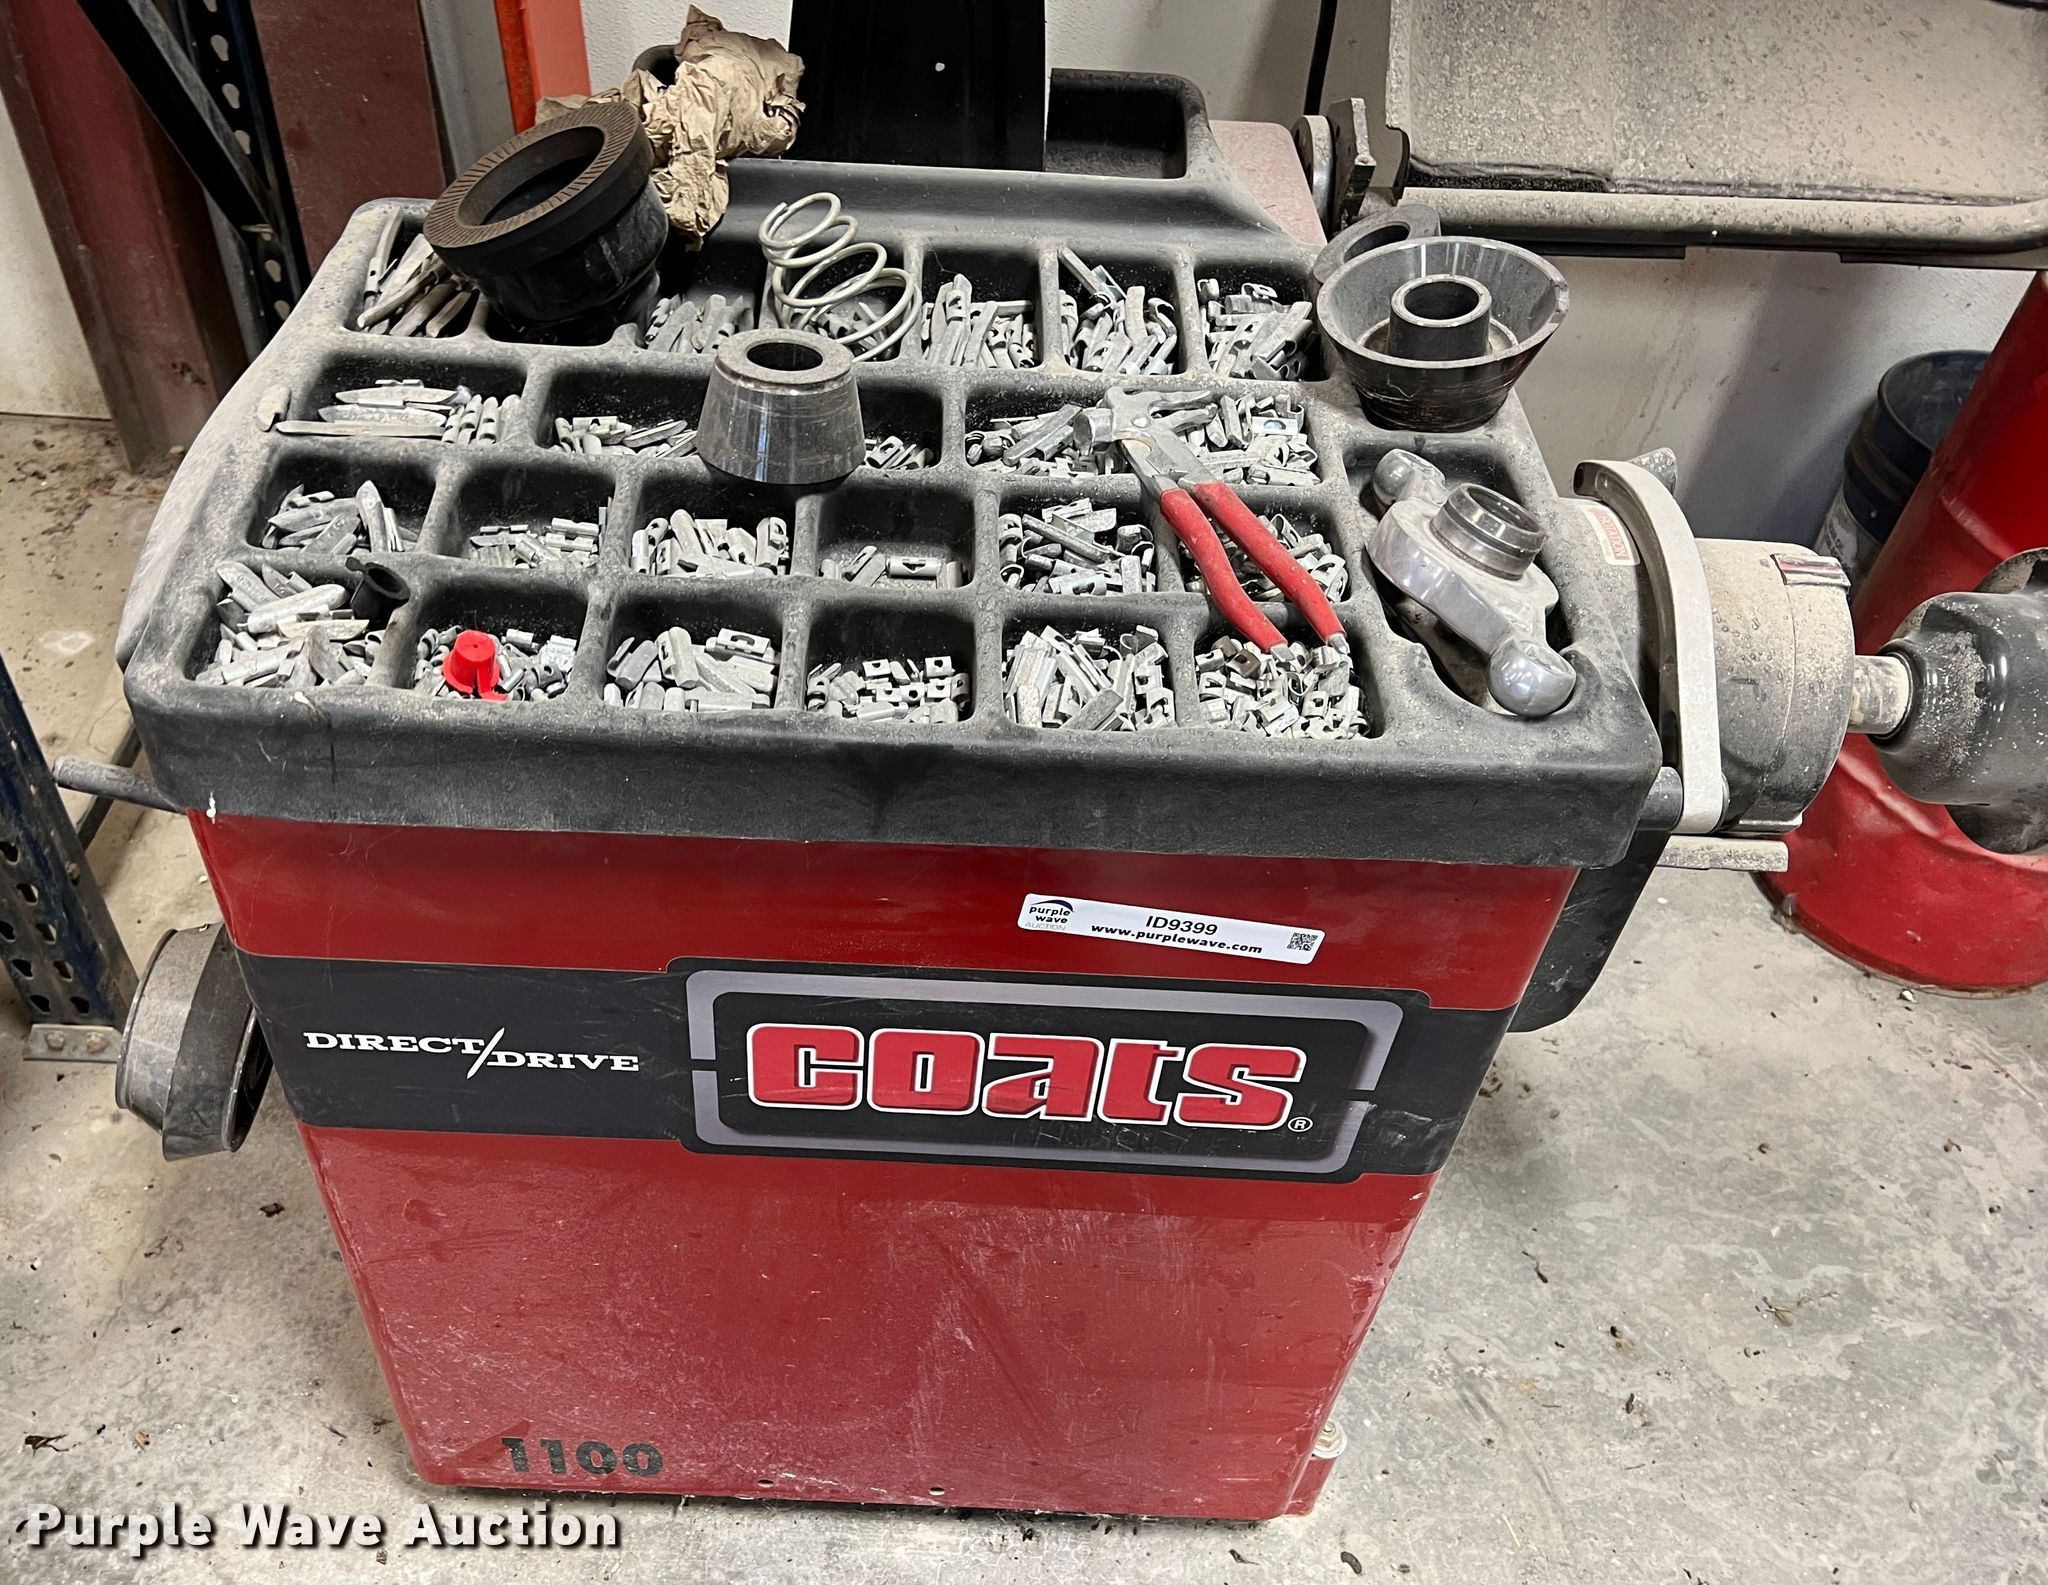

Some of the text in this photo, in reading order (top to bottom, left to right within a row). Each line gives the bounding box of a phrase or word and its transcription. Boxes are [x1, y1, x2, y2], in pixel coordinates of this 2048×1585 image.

[1600, 515, 1629, 557] ROTATION
[1029, 906, 1071, 917] purple
[1035, 915, 1068, 924] wave
[1025, 922, 1067, 931] AUCTION
[1145, 915, 1219, 936] ID9399
[1091, 924, 1263, 954] www.purplewave.com
[746, 1023, 1307, 1132] coats
[501, 1436, 664, 1477] 1100
